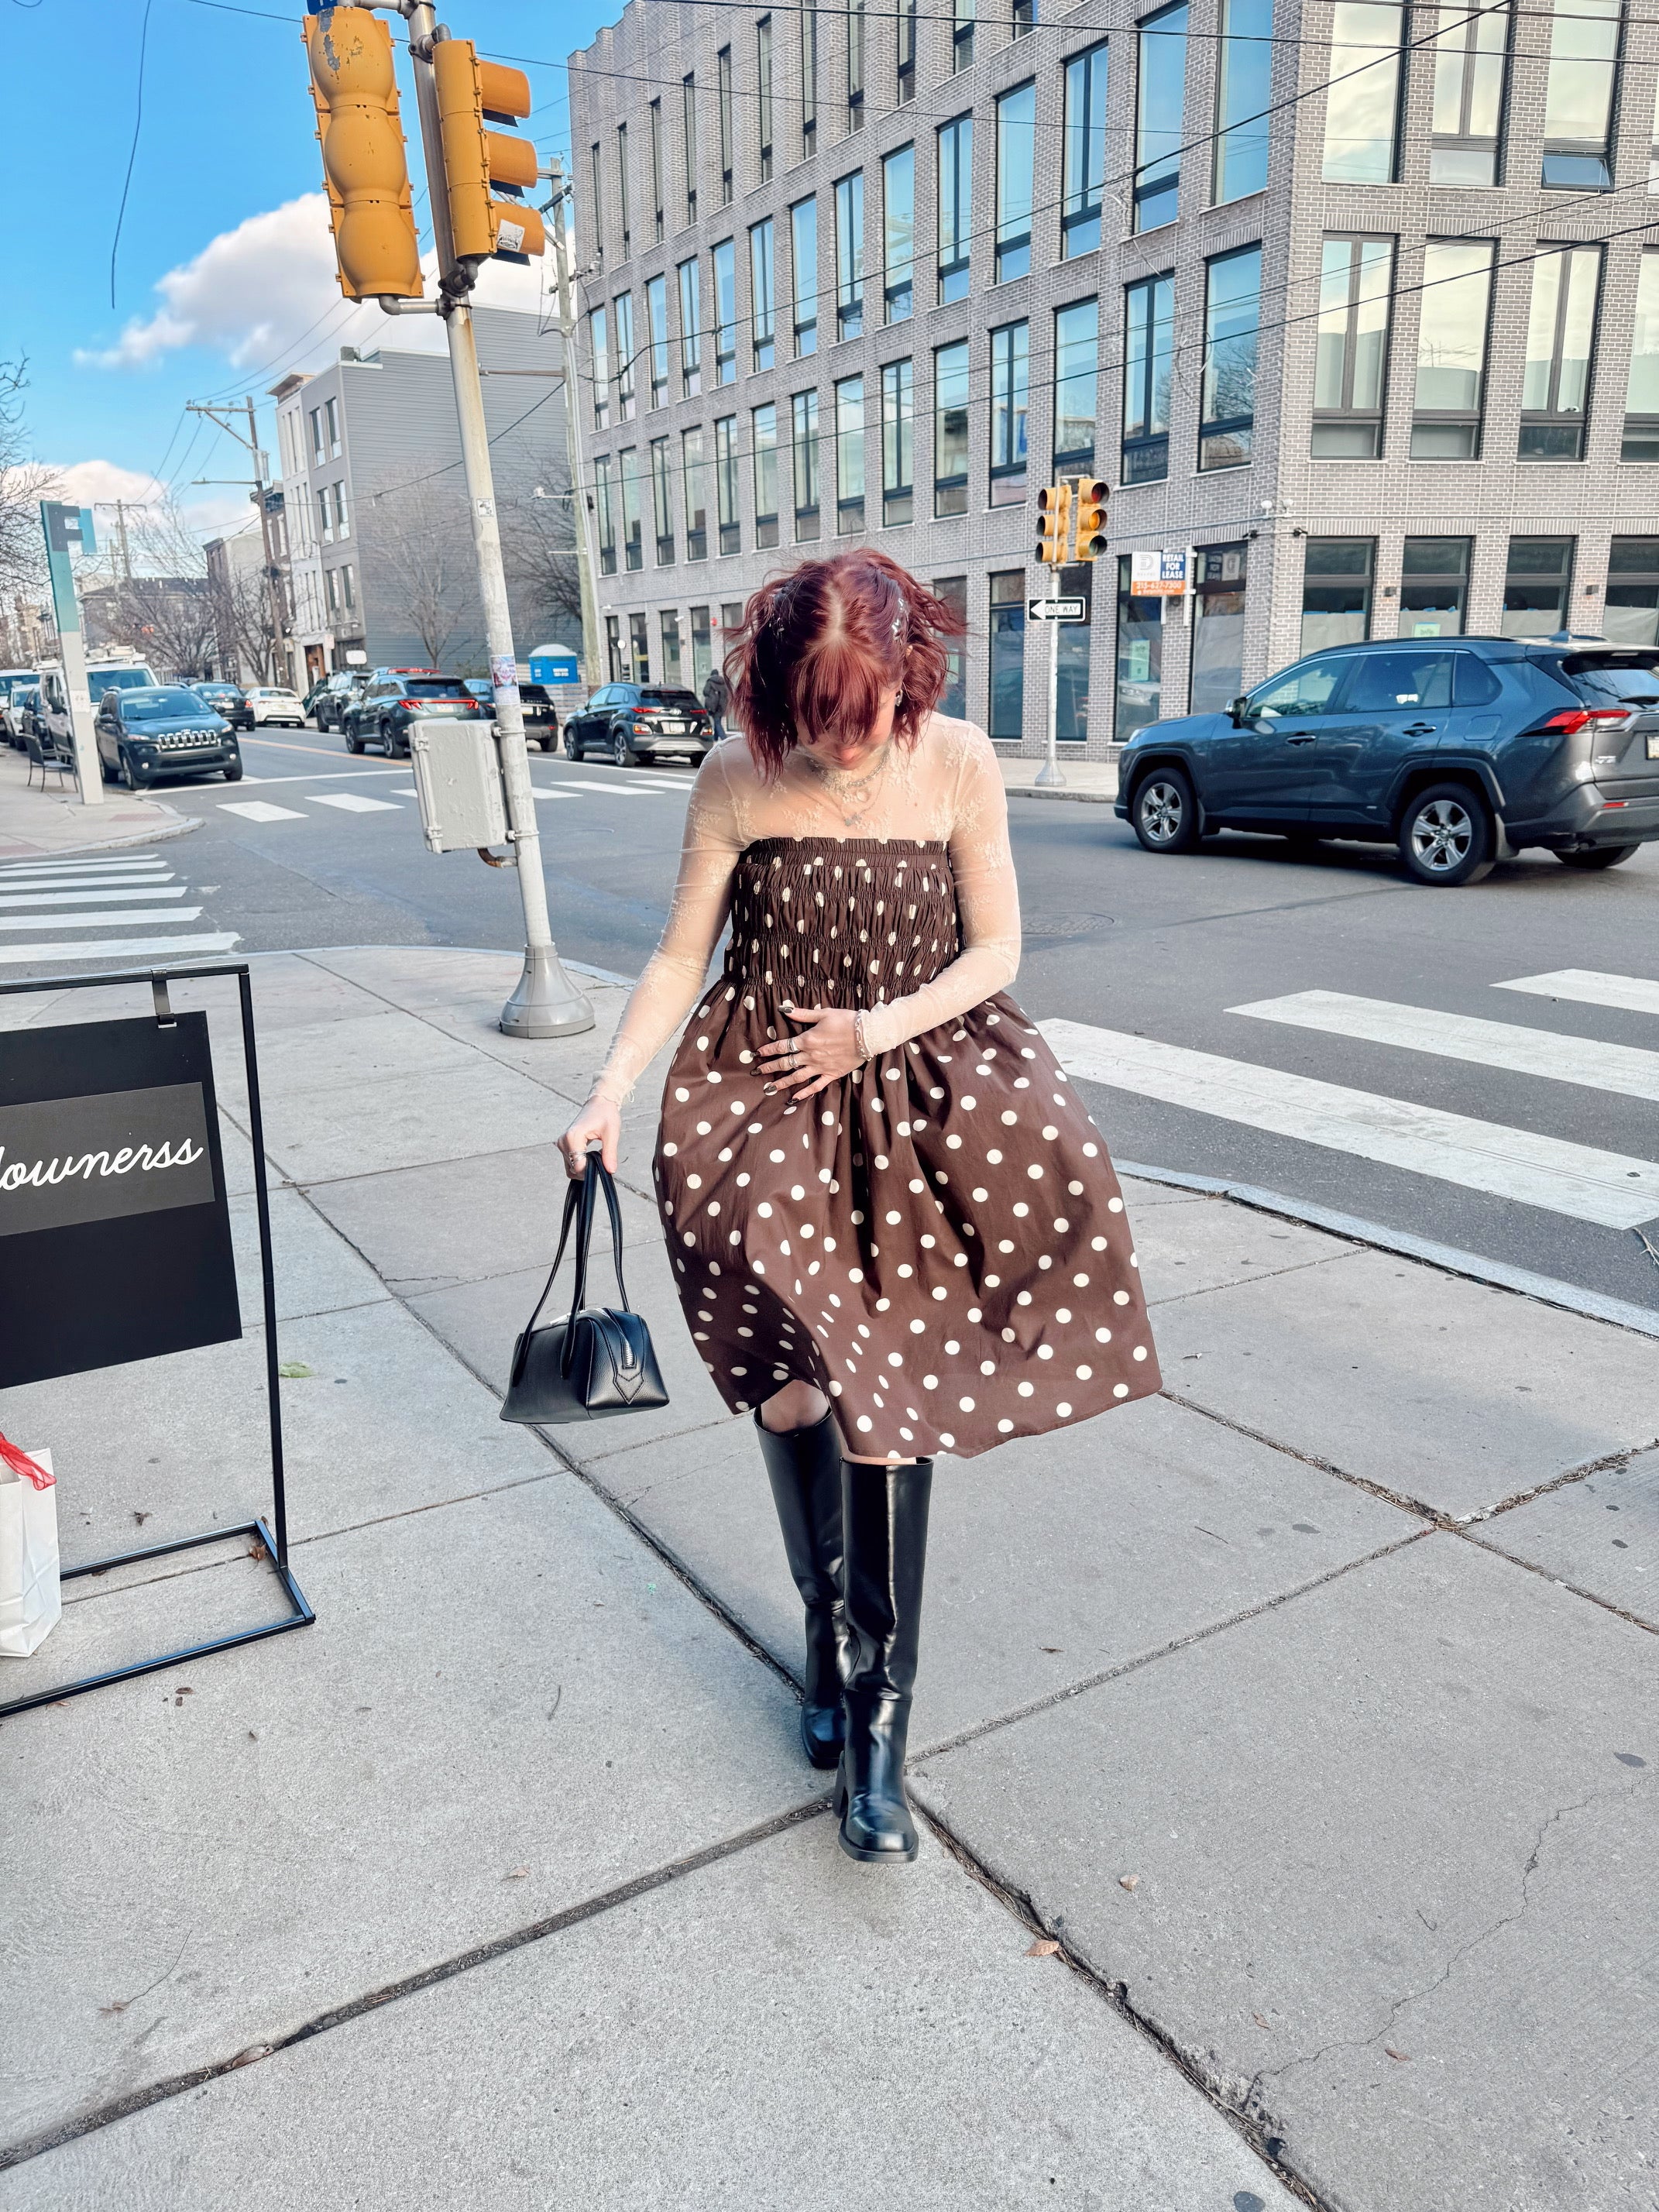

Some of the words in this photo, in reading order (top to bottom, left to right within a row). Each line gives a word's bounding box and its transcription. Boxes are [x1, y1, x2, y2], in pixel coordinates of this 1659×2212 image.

[1163, 554, 1184, 562] RETAIL
[1045, 605, 1060, 614] ONE
[1063, 605, 1078, 613] WAY
